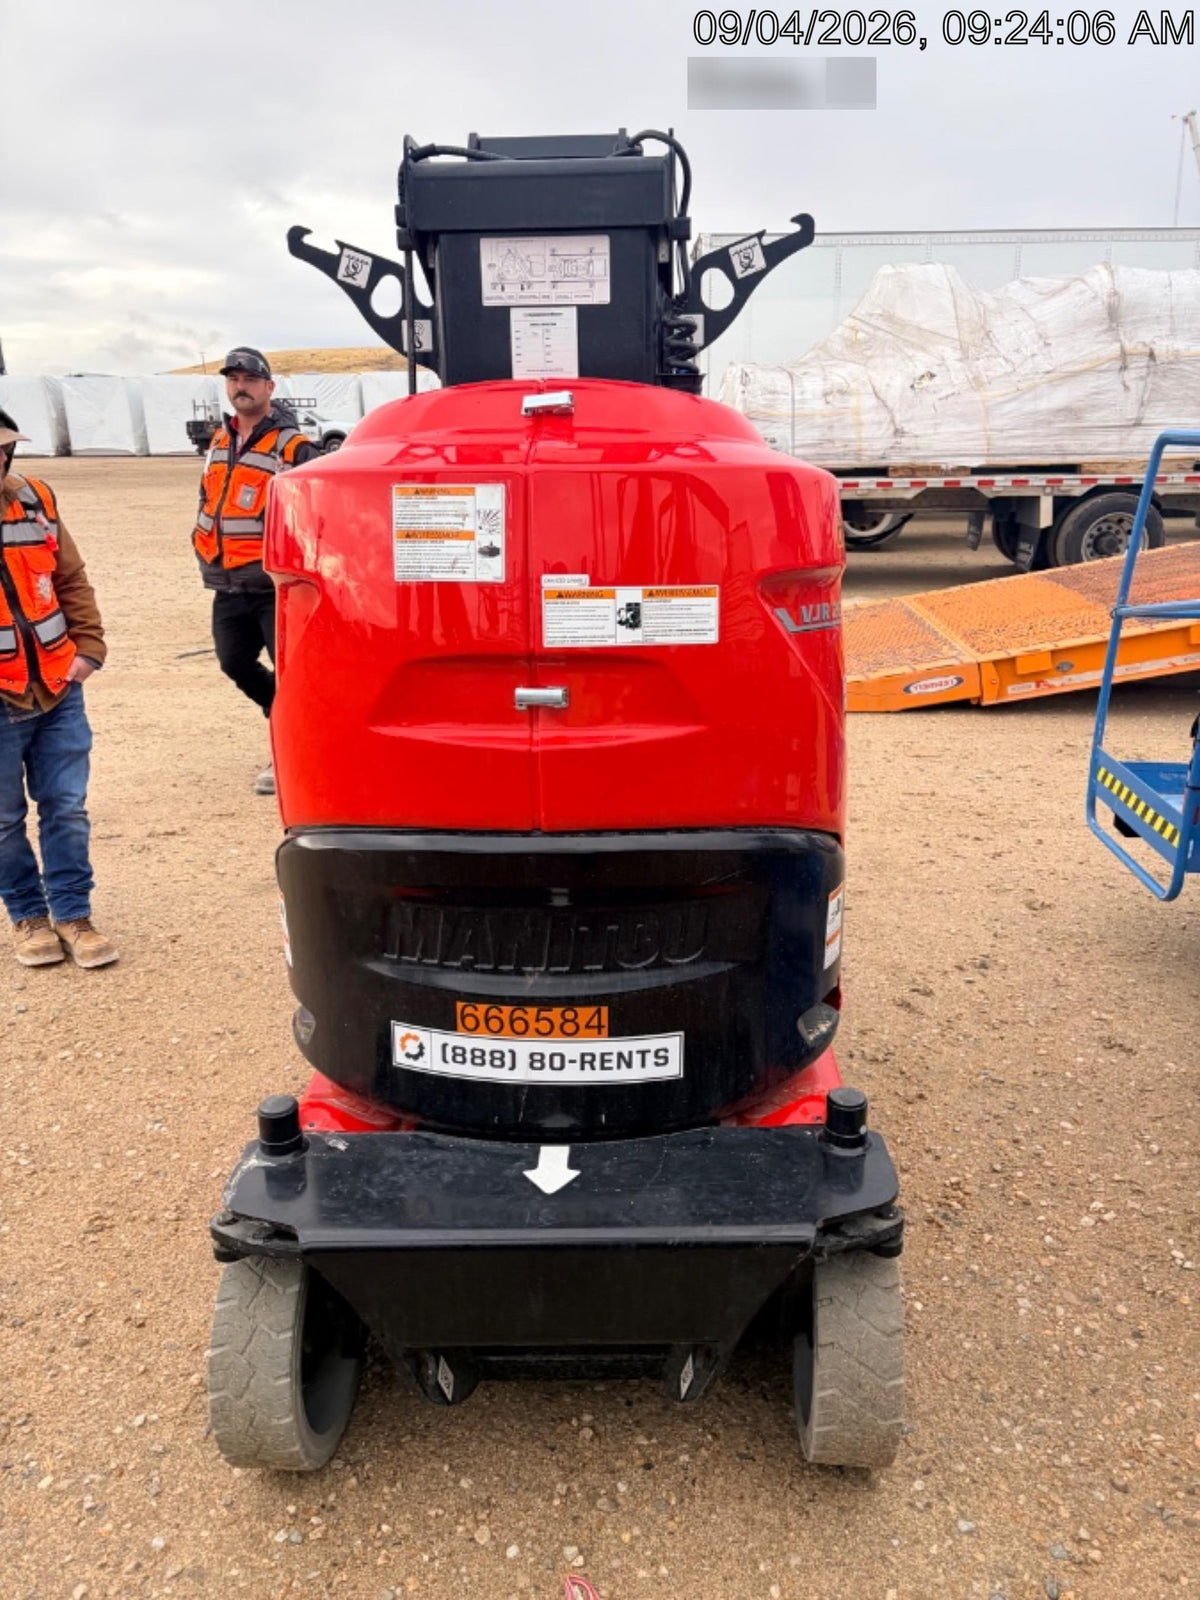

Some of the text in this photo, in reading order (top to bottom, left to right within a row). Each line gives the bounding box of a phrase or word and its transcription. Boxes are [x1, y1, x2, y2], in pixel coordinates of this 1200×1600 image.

[384, 903, 707, 972] MANITOU
[459, 1003, 606, 1036] 666584
[441, 1043, 669, 1071] (888) 80-RENTS
